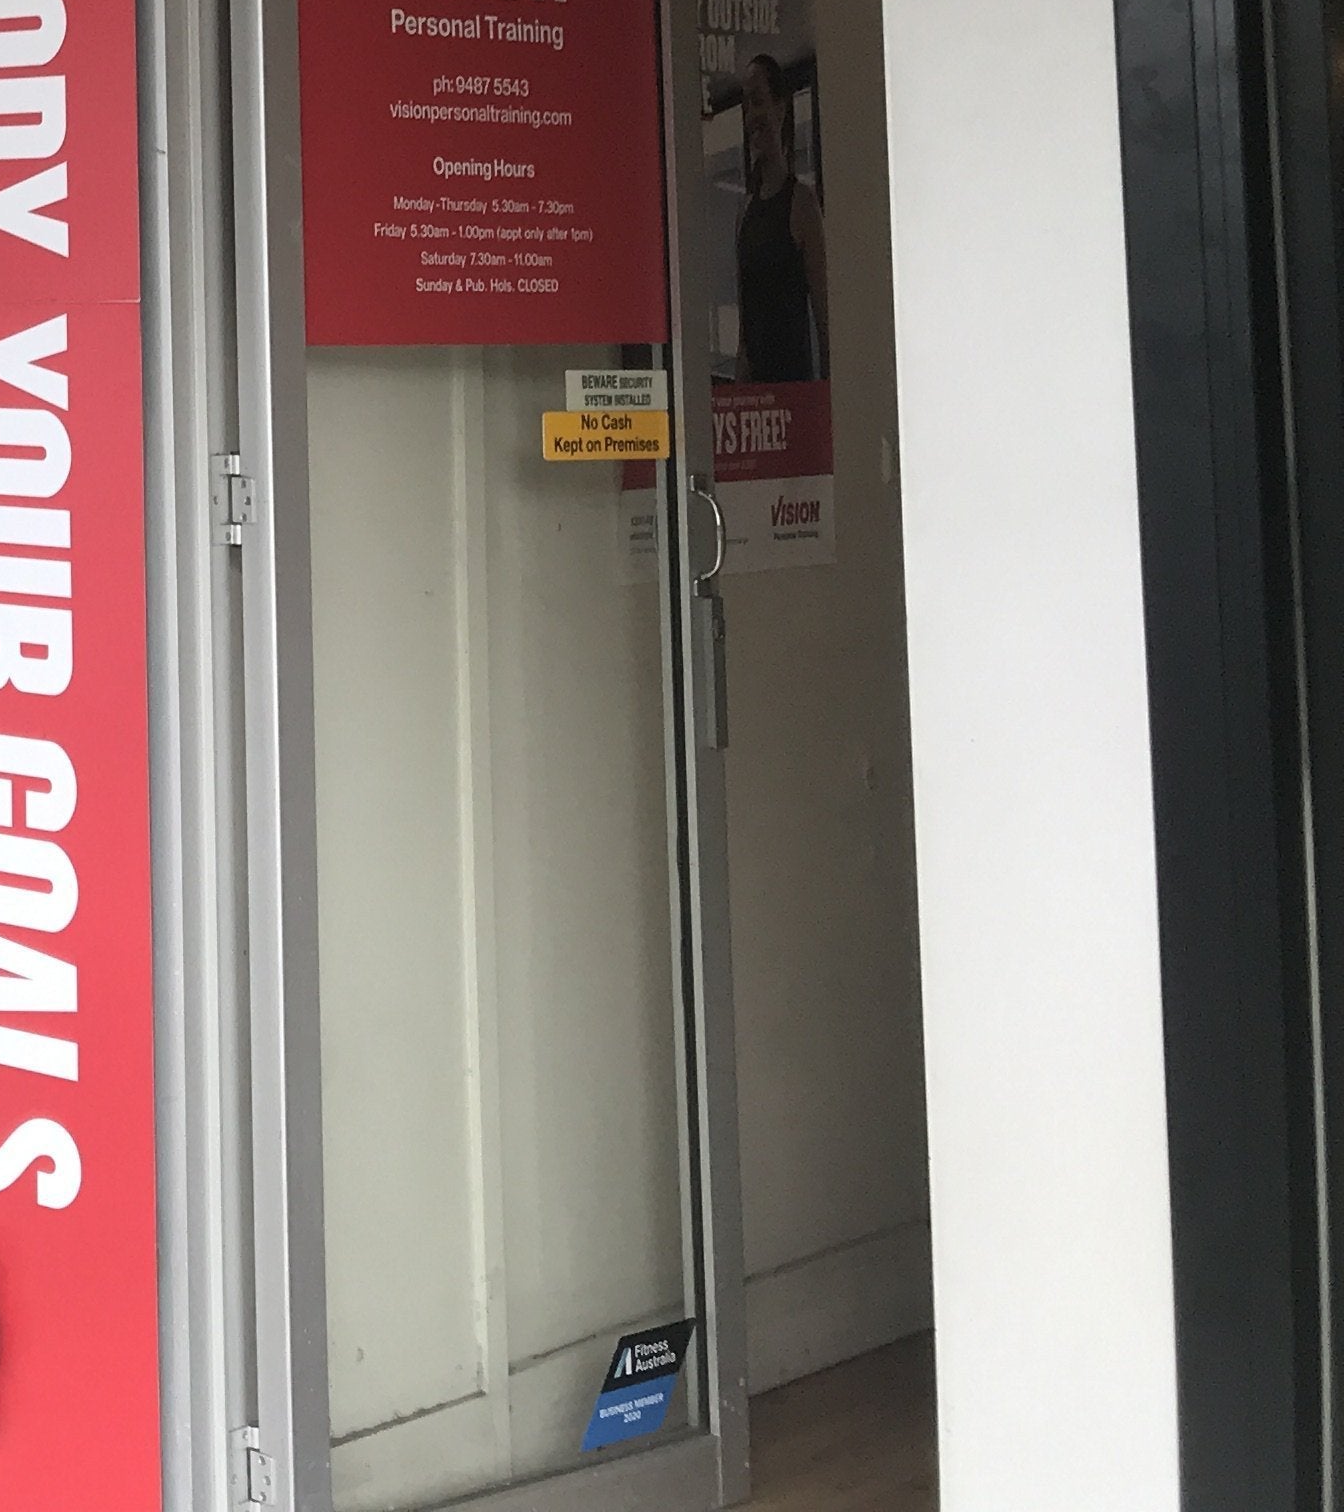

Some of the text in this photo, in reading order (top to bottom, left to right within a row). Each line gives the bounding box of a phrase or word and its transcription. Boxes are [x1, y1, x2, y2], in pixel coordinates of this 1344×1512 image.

[390, 7, 564, 50] Personal Training
[433, 75, 529, 97] ph: 9487 5543
[390, 99, 572, 129] visionpersonaltraining.com
[433, 155, 535, 181] Opening Hours
[492, 198, 529, 213] 5.30am
[538, 199, 574, 215] 7.30pm
[374, 222, 593, 242] Friday 5.30am 1.00pm (appt only after 1pm)
[420, 251, 552, 268] Saturday 7.30am 11.00am
[415, 277, 559, 294] Sunday & Pub. Hols. CLOSED
[581, 375, 653, 390] BEWARE SECURITY
[584, 394, 652, 407] SYSTEM INSTALLED
[581, 414, 632, 430] No Cash
[554, 437, 659, 456] Kept on Premises
[770, 495, 820, 527] VISION
[634, 1339, 669, 1358] Fitness
[635, 1352, 677, 1373] Australia
